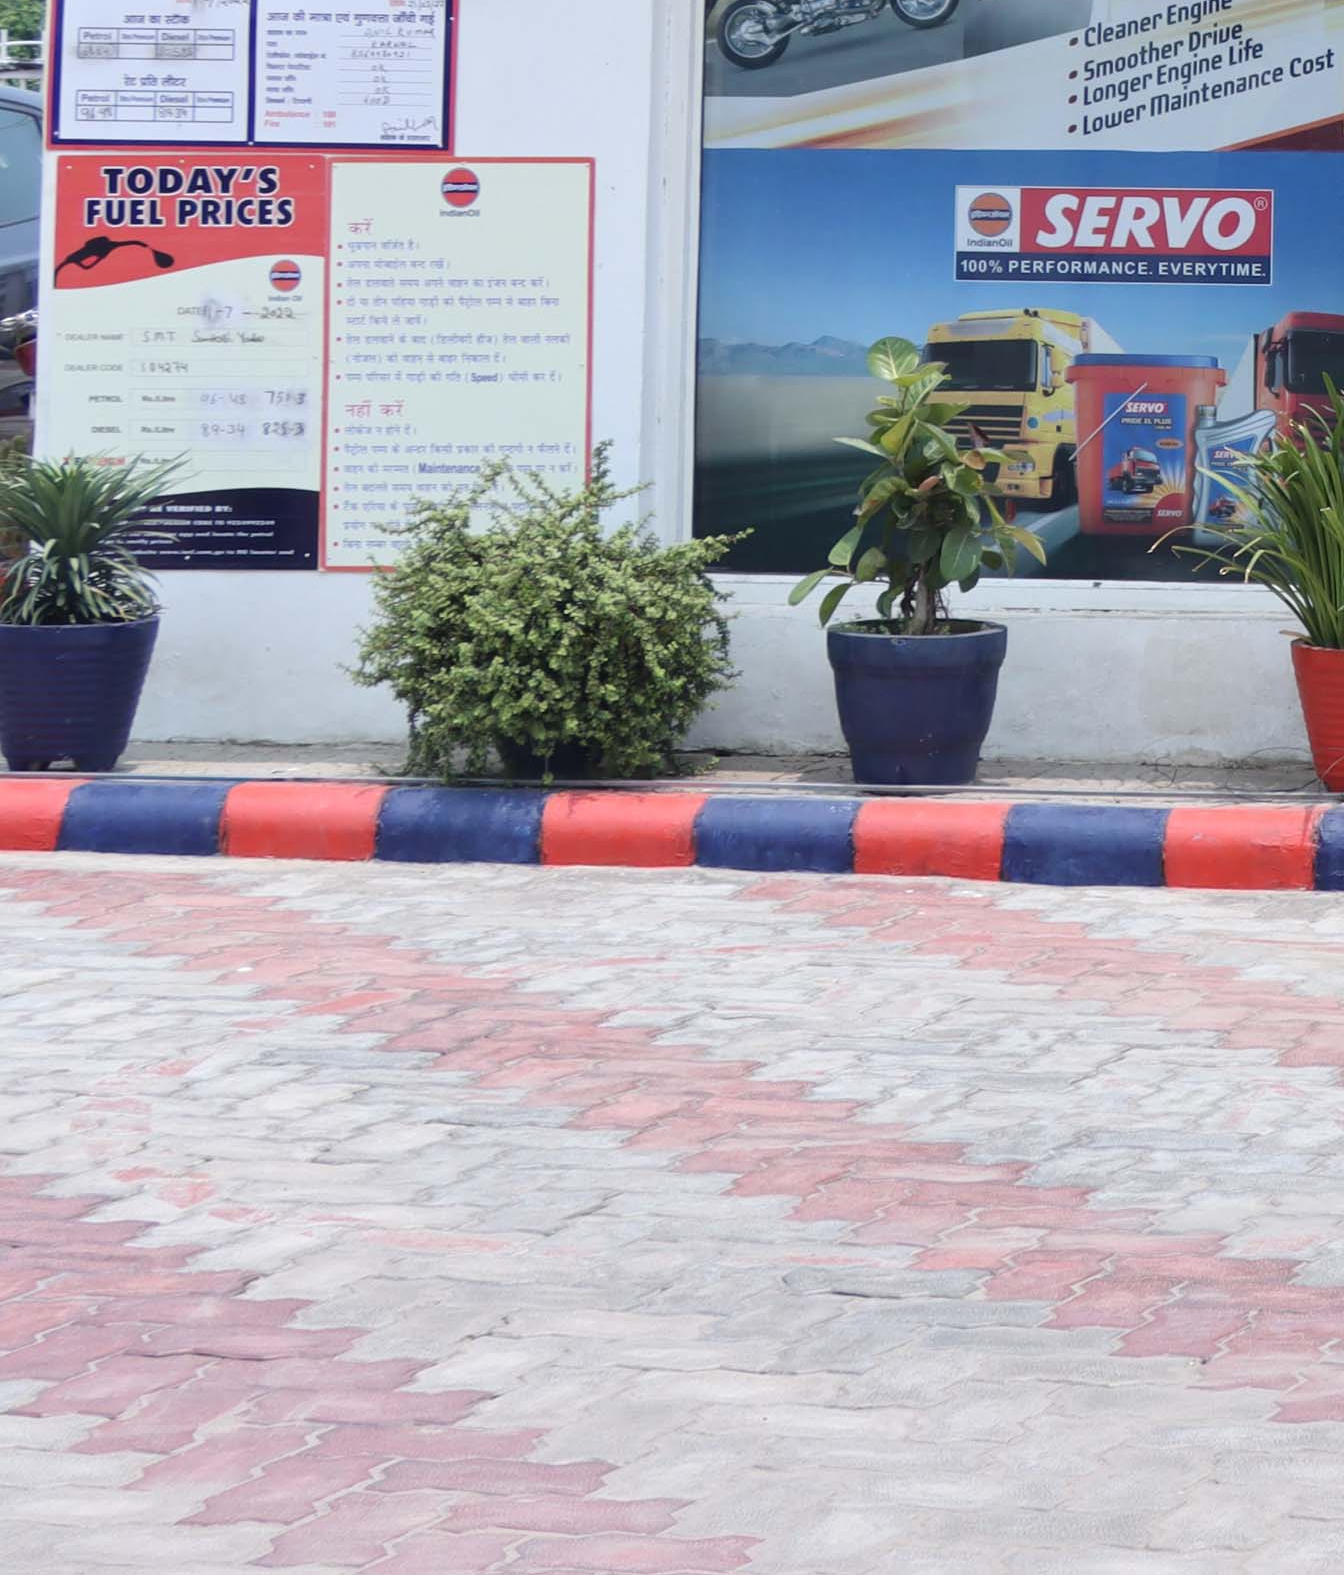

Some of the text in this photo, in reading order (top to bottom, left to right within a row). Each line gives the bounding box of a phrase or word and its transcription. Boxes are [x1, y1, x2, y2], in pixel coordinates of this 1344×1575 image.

[1084, 12, 1162, 47] Cleaner
[83, 32, 189, 41] Petrol Diesel
[1084, 22, 1243, 81] Smoother Drive
[1083, 38, 1264, 106] Longer Engine Life
[1083, 48, 1335, 136] Lower Maintenance Cost
[81, 94, 188, 103] Petrol Diesel
[102, 167, 278, 195] TODAY'S
[86, 198, 295, 226] FUEL PRICES
[439, 209, 481, 217] IndianOil
[1035, 193, 1256, 251] SERVO
[967, 239, 1013, 248] IndianOil
[960, 259, 1266, 277] 100% PERFORMANCE. EVERYTIME.
[65, 333, 98, 341] DEALER
[100, 333, 124, 341] NAME
[64, 364, 98, 372] DEALER
[89, 395, 123, 403] PETROL
[1125, 402, 1164, 413] SERVO
[91, 426, 122, 434] DIESEL
